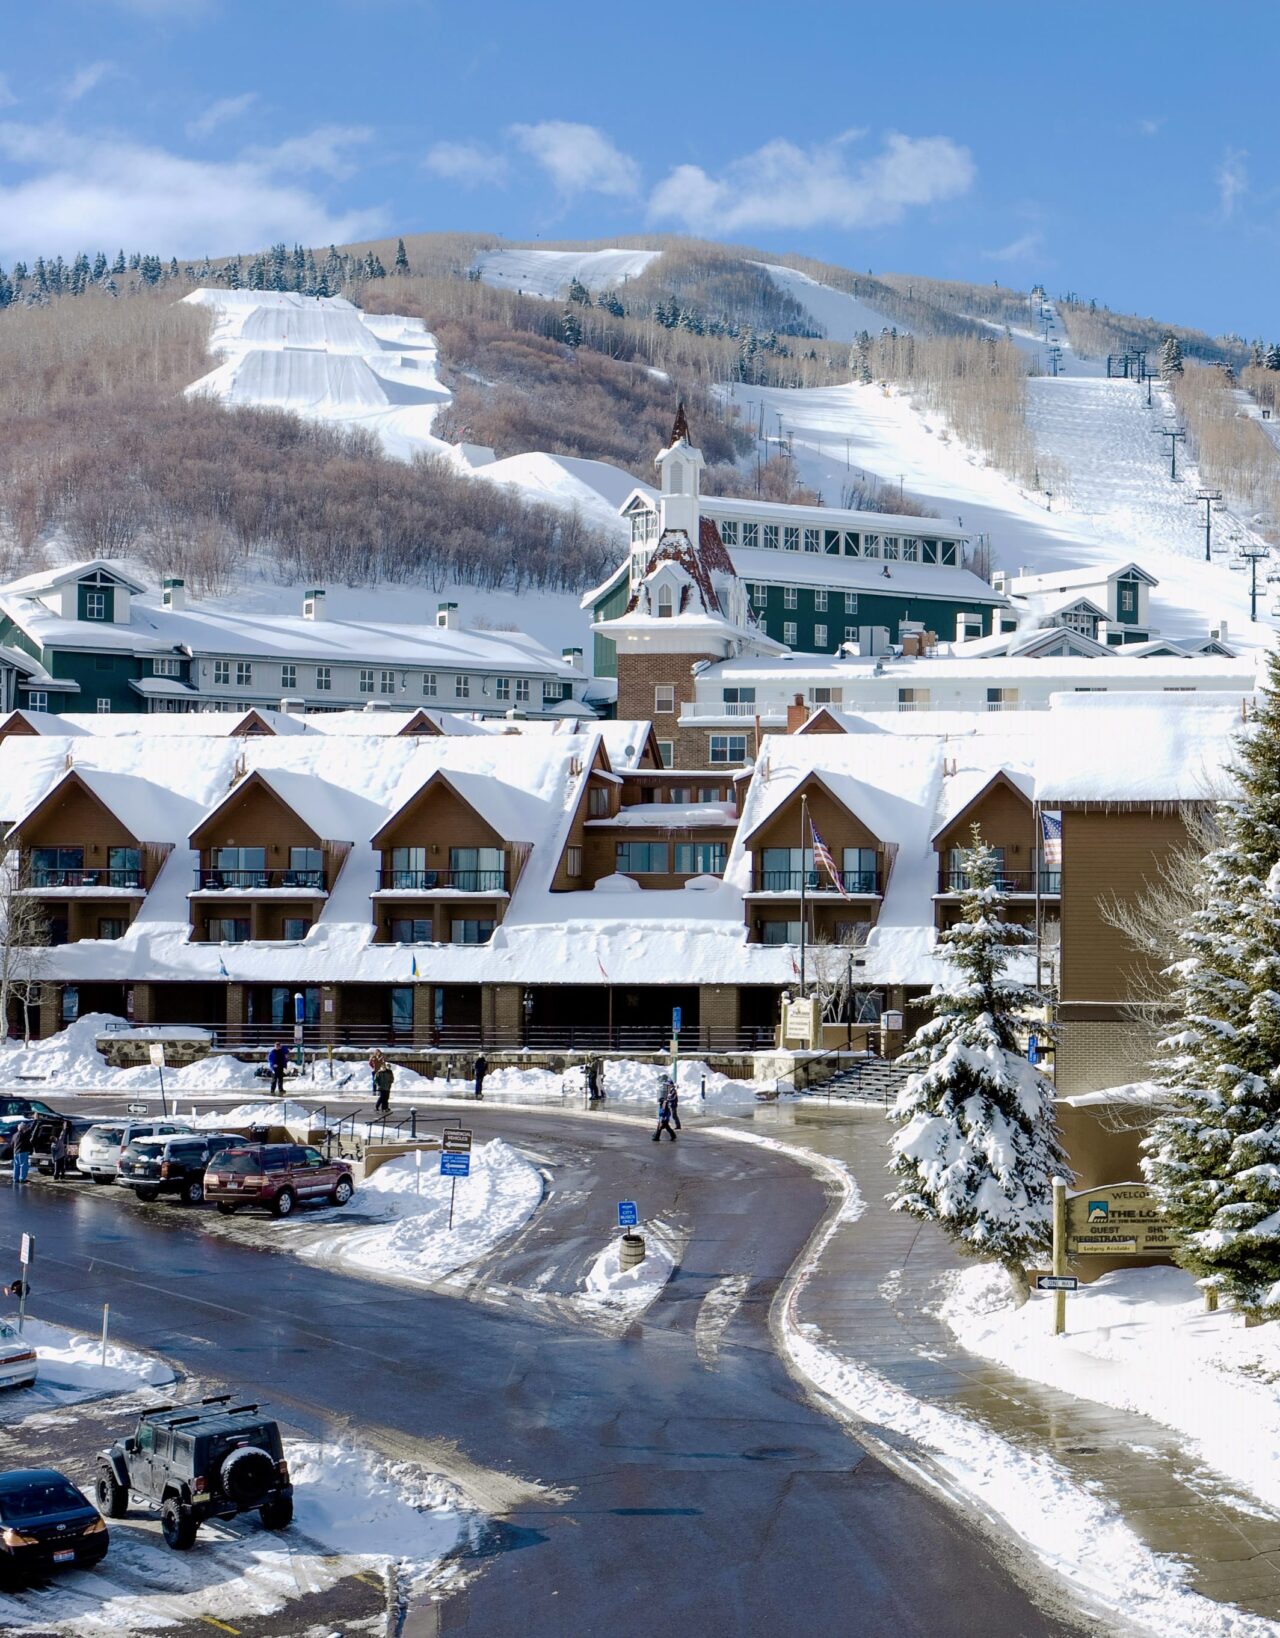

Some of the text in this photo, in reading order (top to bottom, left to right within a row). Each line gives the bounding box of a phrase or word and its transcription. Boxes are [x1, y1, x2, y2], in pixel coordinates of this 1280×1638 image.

[1112, 1191, 1149, 1200] WELCO
[1109, 1210, 1157, 1218] THE LO
[1090, 1226, 1120, 1234] GUEST
